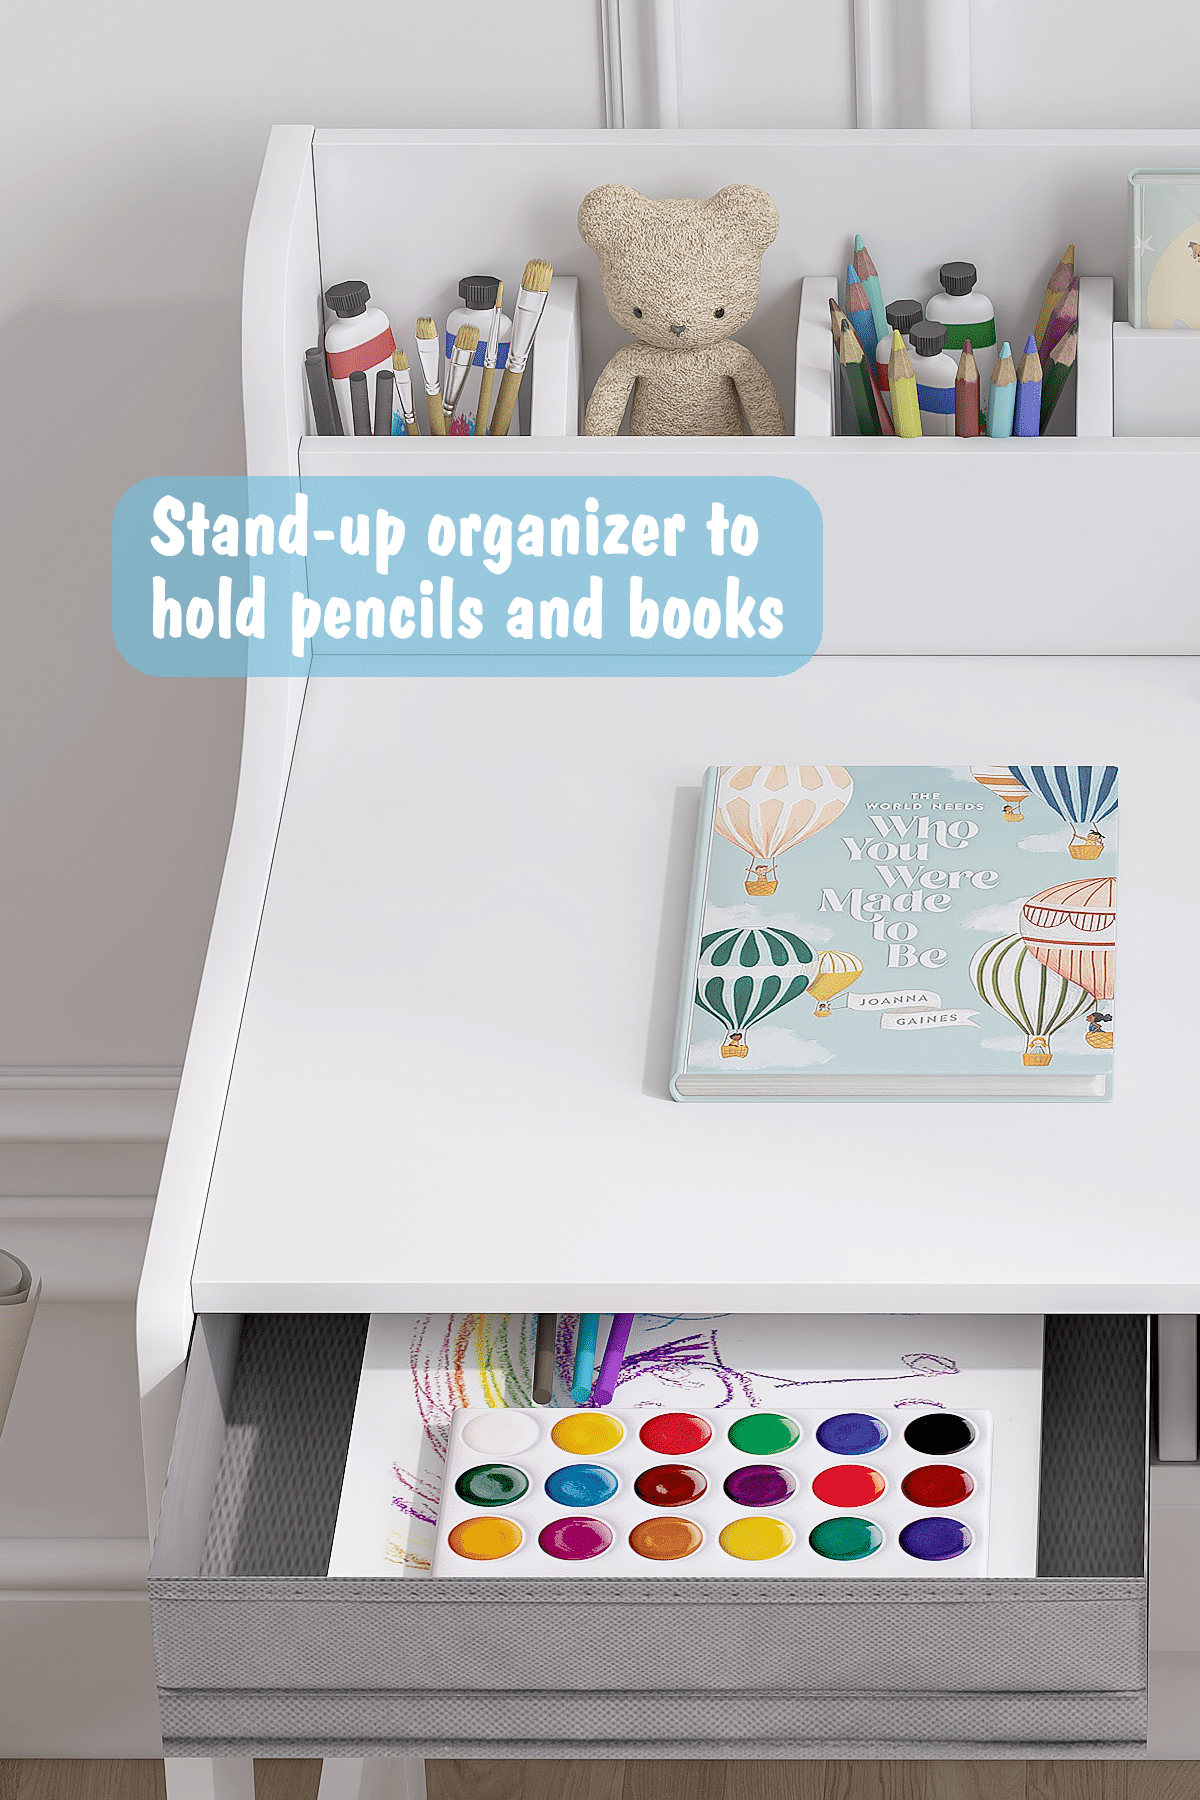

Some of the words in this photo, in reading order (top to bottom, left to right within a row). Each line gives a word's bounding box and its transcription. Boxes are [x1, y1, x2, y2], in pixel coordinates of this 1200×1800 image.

[865, 802, 923, 811] WORLD
[931, 802, 984, 811] NEEDS
[910, 792, 941, 800] THE
[868, 815, 979, 849] Who
[841, 837, 928, 861] You
[874, 865, 999, 889] Were
[817, 888, 952, 923] Made
[872, 915, 918, 942] to
[886, 943, 948, 968] Be
[859, 994, 929, 1007] JOANNA
[896, 1014, 958, 1026] GAINES
